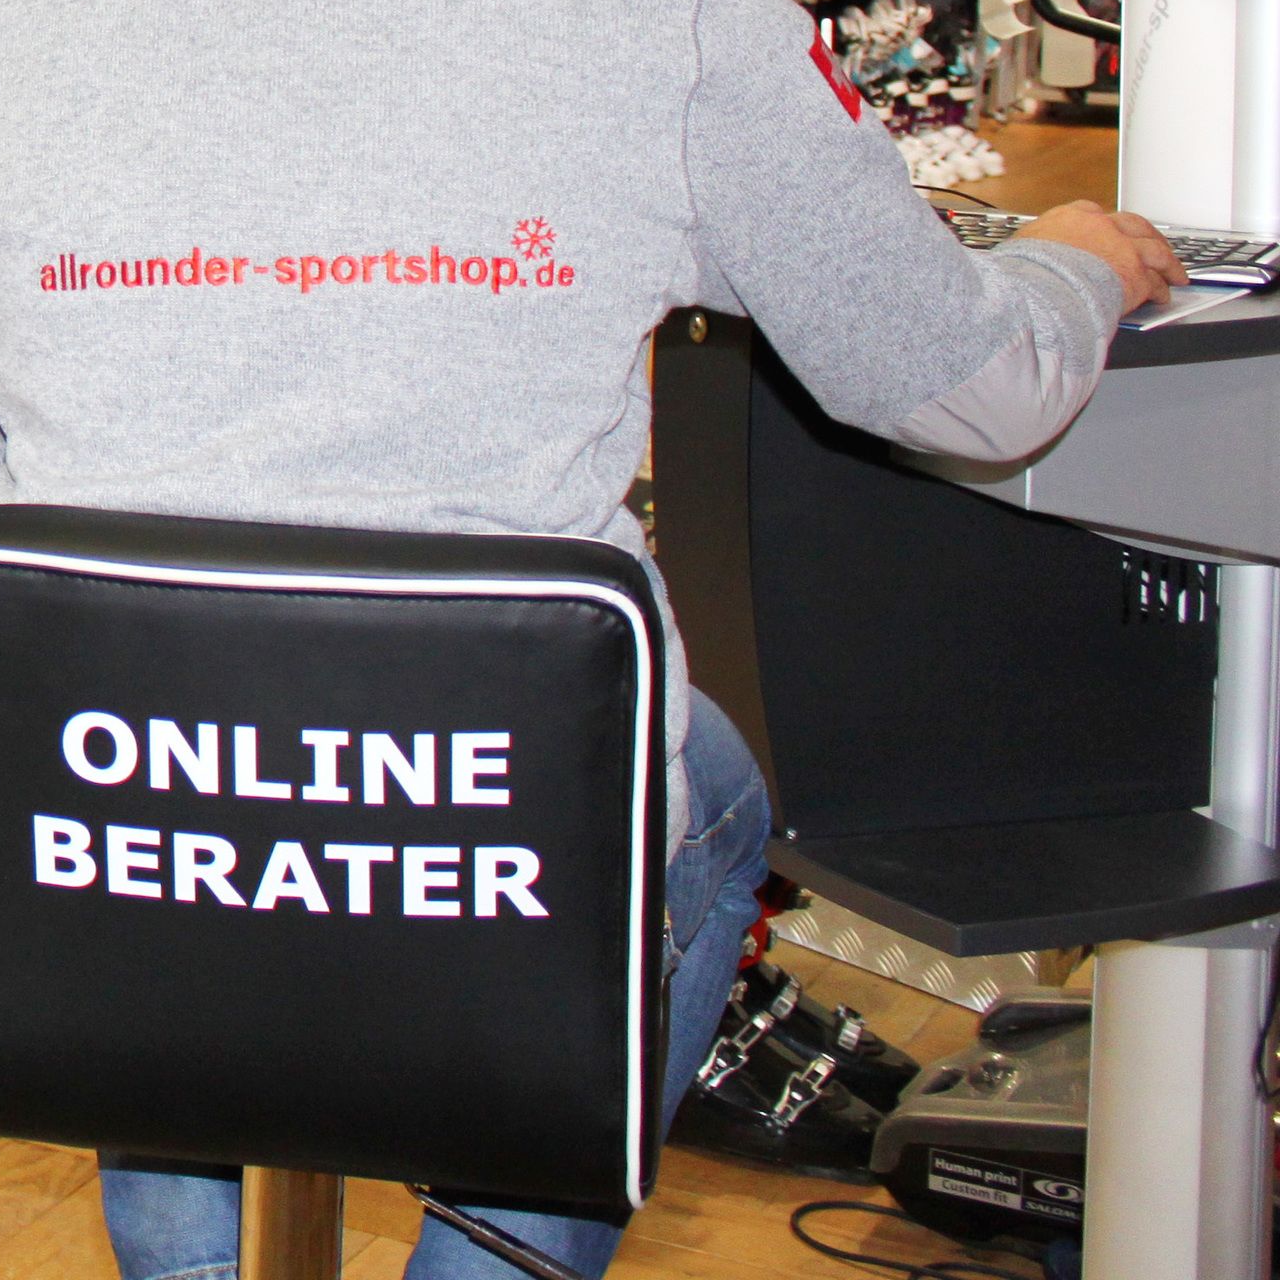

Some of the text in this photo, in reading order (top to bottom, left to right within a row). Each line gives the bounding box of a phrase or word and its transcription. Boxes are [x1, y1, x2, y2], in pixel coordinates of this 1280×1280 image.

[40, 245, 575, 295] allrounder-sportshop.de
[61, 710, 512, 807] ONLINE
[33, 814, 550, 918] BERATER
[934, 1157, 1018, 1187] Human print
[941, 1179, 1009, 1204] Custom fit
[1025, 1200, 1079, 1219] SALOM
